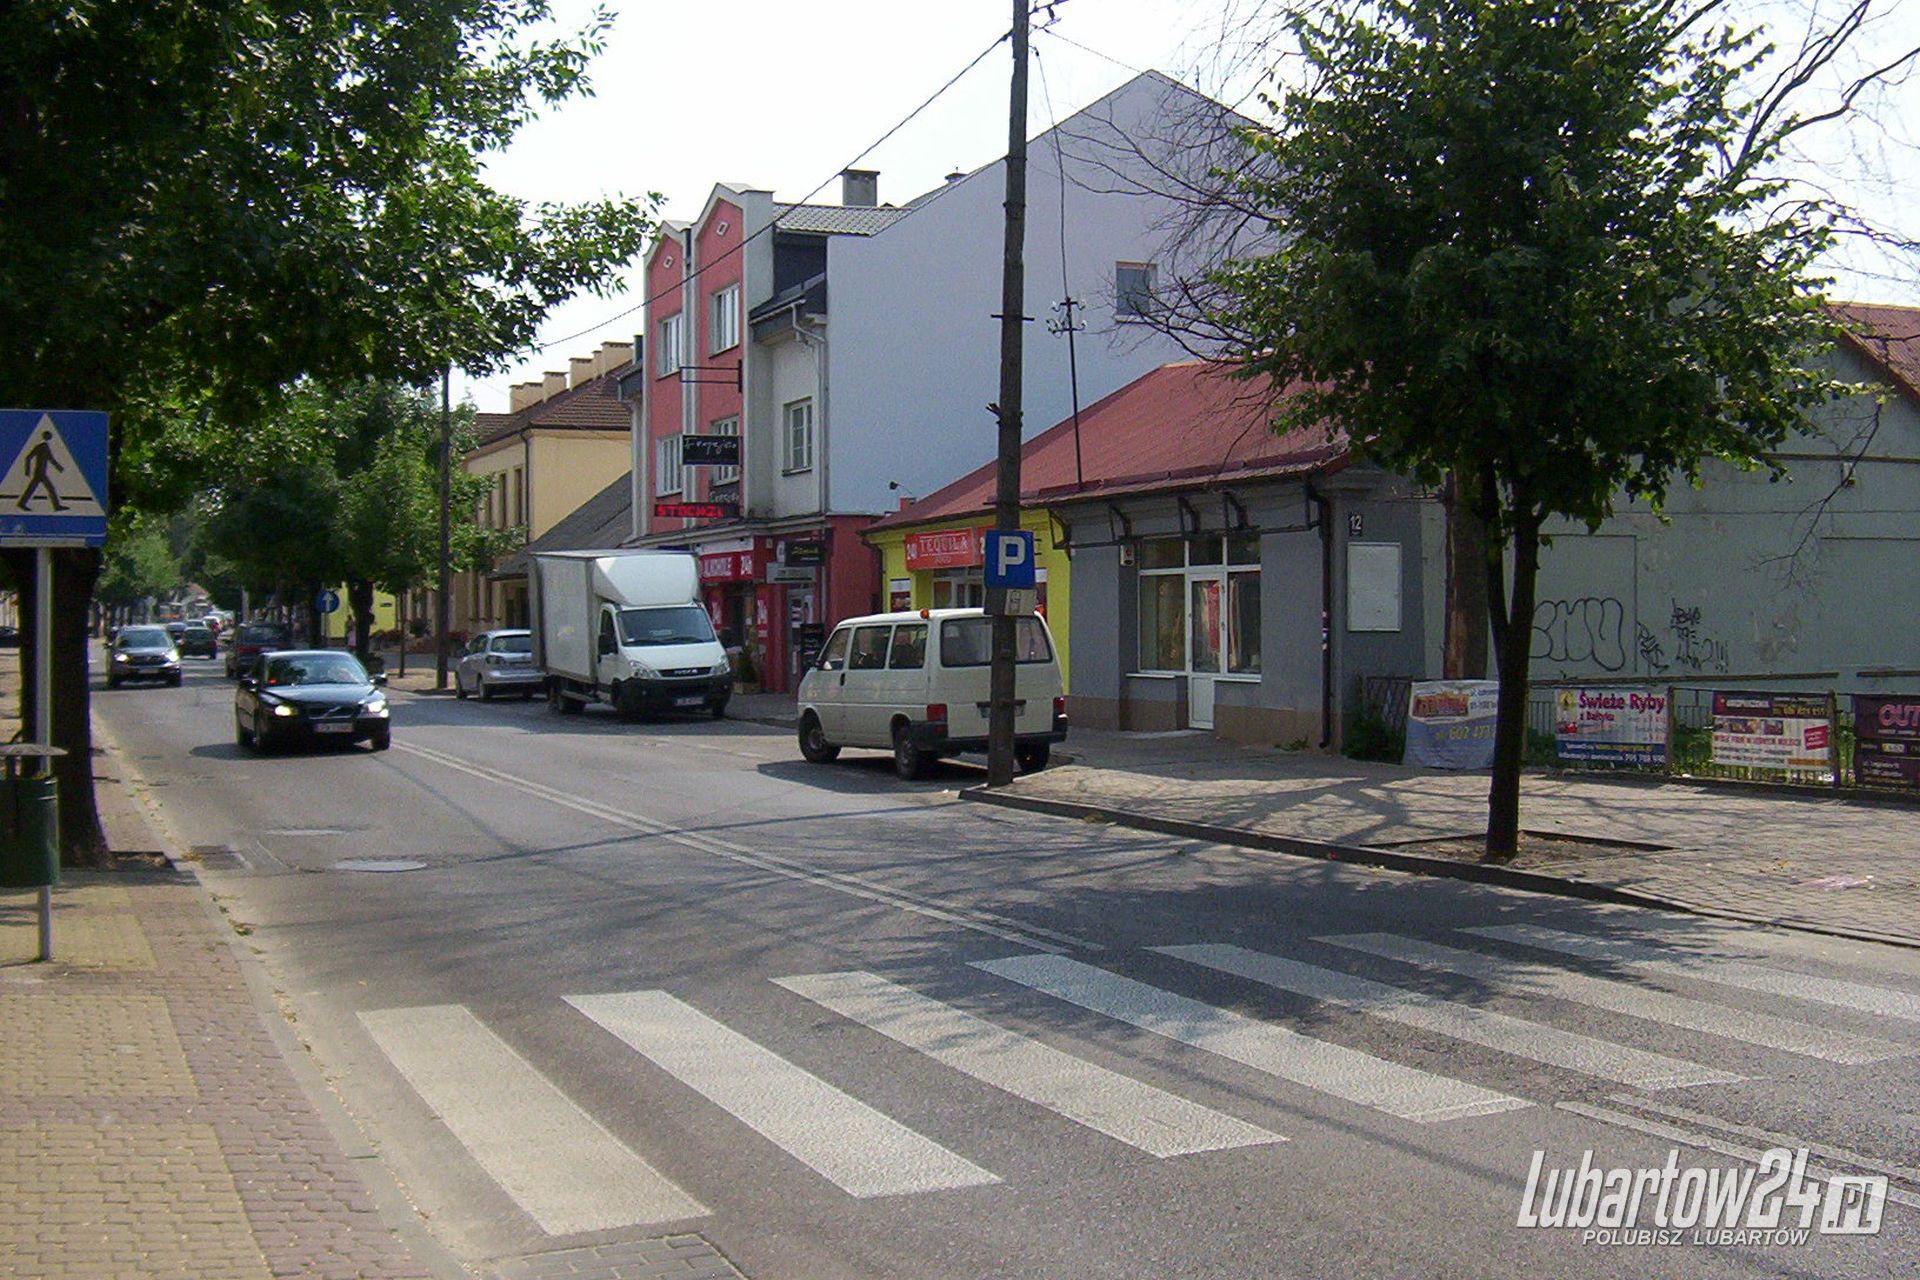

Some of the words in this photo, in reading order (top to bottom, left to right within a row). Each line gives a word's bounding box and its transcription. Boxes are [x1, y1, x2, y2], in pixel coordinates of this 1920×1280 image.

[1350, 515, 1362, 530] 12
[920, 536, 968, 554] TEQUILA
[997, 535, 1026, 576] P
[1579, 688, 1626, 709] Świeże
[1629, 692, 1665, 714] Ryby
